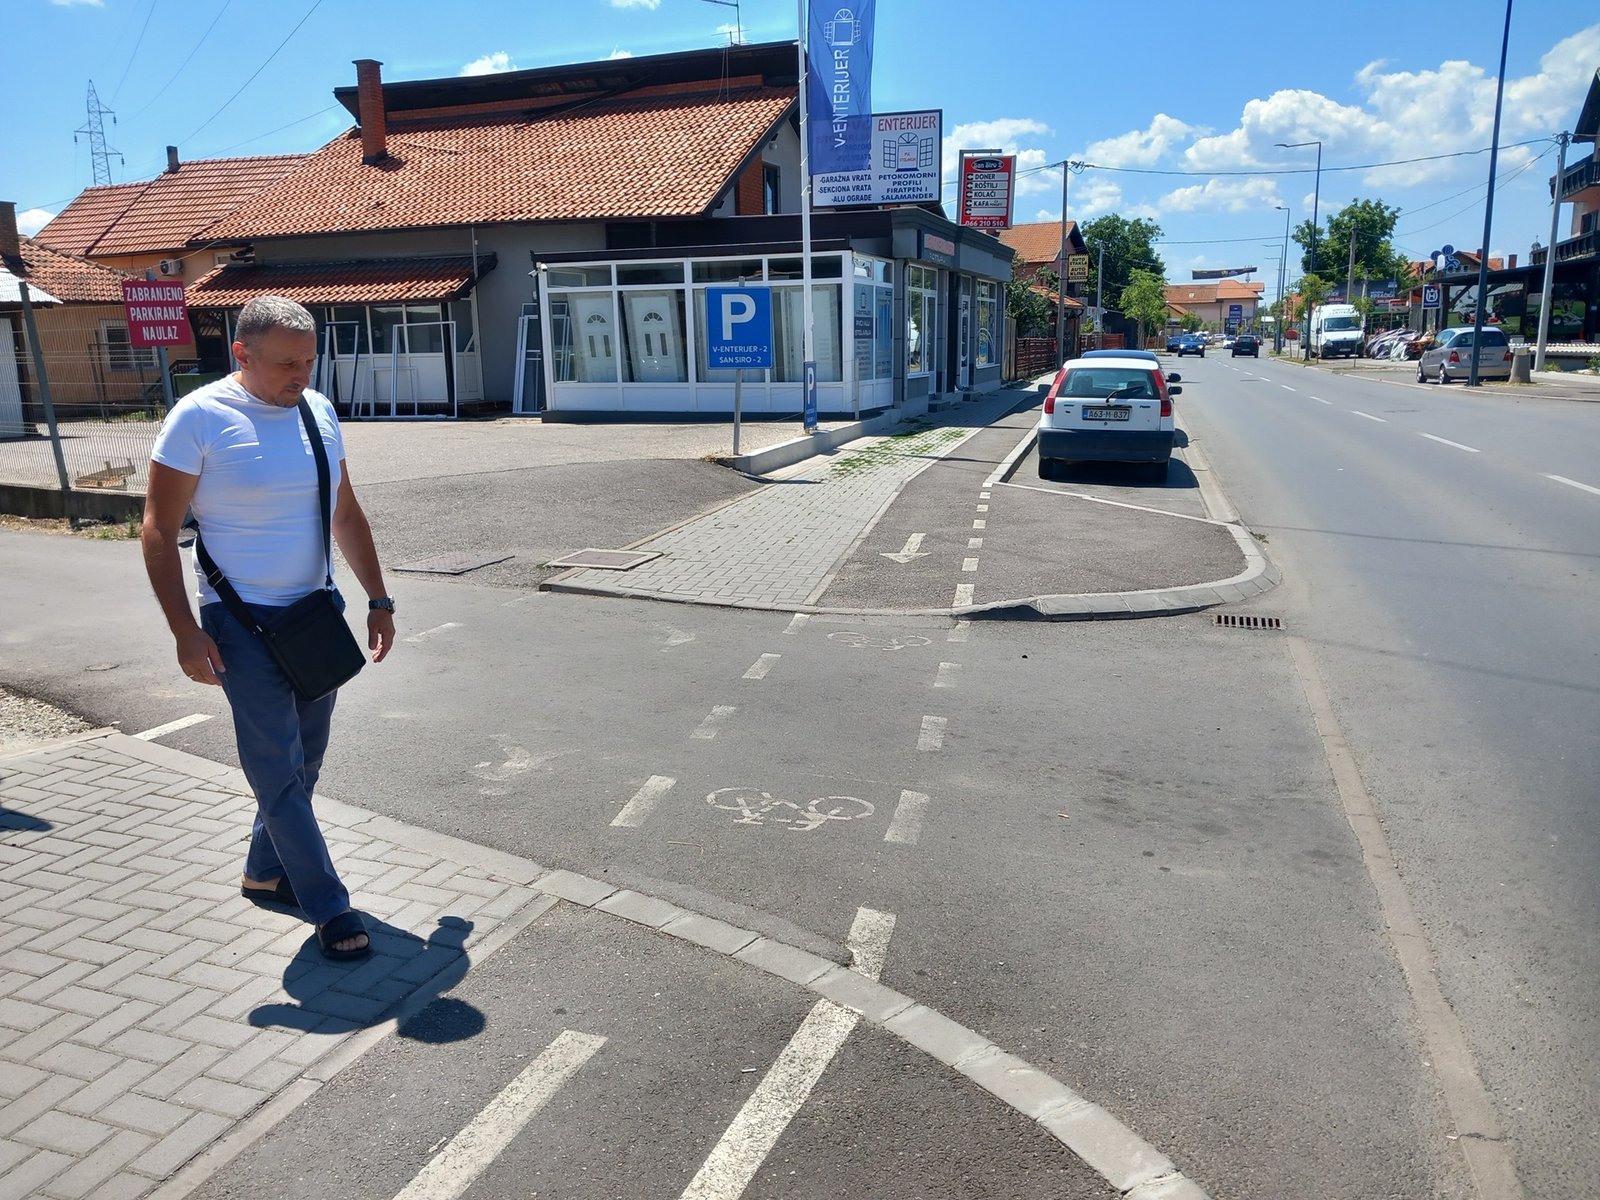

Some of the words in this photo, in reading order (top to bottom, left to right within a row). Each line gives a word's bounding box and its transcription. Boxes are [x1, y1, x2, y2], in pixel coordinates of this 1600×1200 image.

[832, 48, 851, 149] V-ENTERIJER
[878, 115, 937, 132] ENTERIJER
[851, 174, 872, 182] VRATA
[878, 172, 937, 181] PETOKOMORNI
[851, 184, 872, 192] VRATA
[974, 181, 998, 189] ROŠTILJ
[846, 194, 872, 202] OGRADE
[880, 193, 934, 201] SALAMANDER
[125, 287, 184, 302] ZABRANJENO
[130, 306, 185, 321] PARKIRANJE
[721, 293, 756, 341] P
[719, 356, 734, 364] SAN
[807, 367, 815, 405] P
[1088, 410, 1128, 419] A63-M-837
